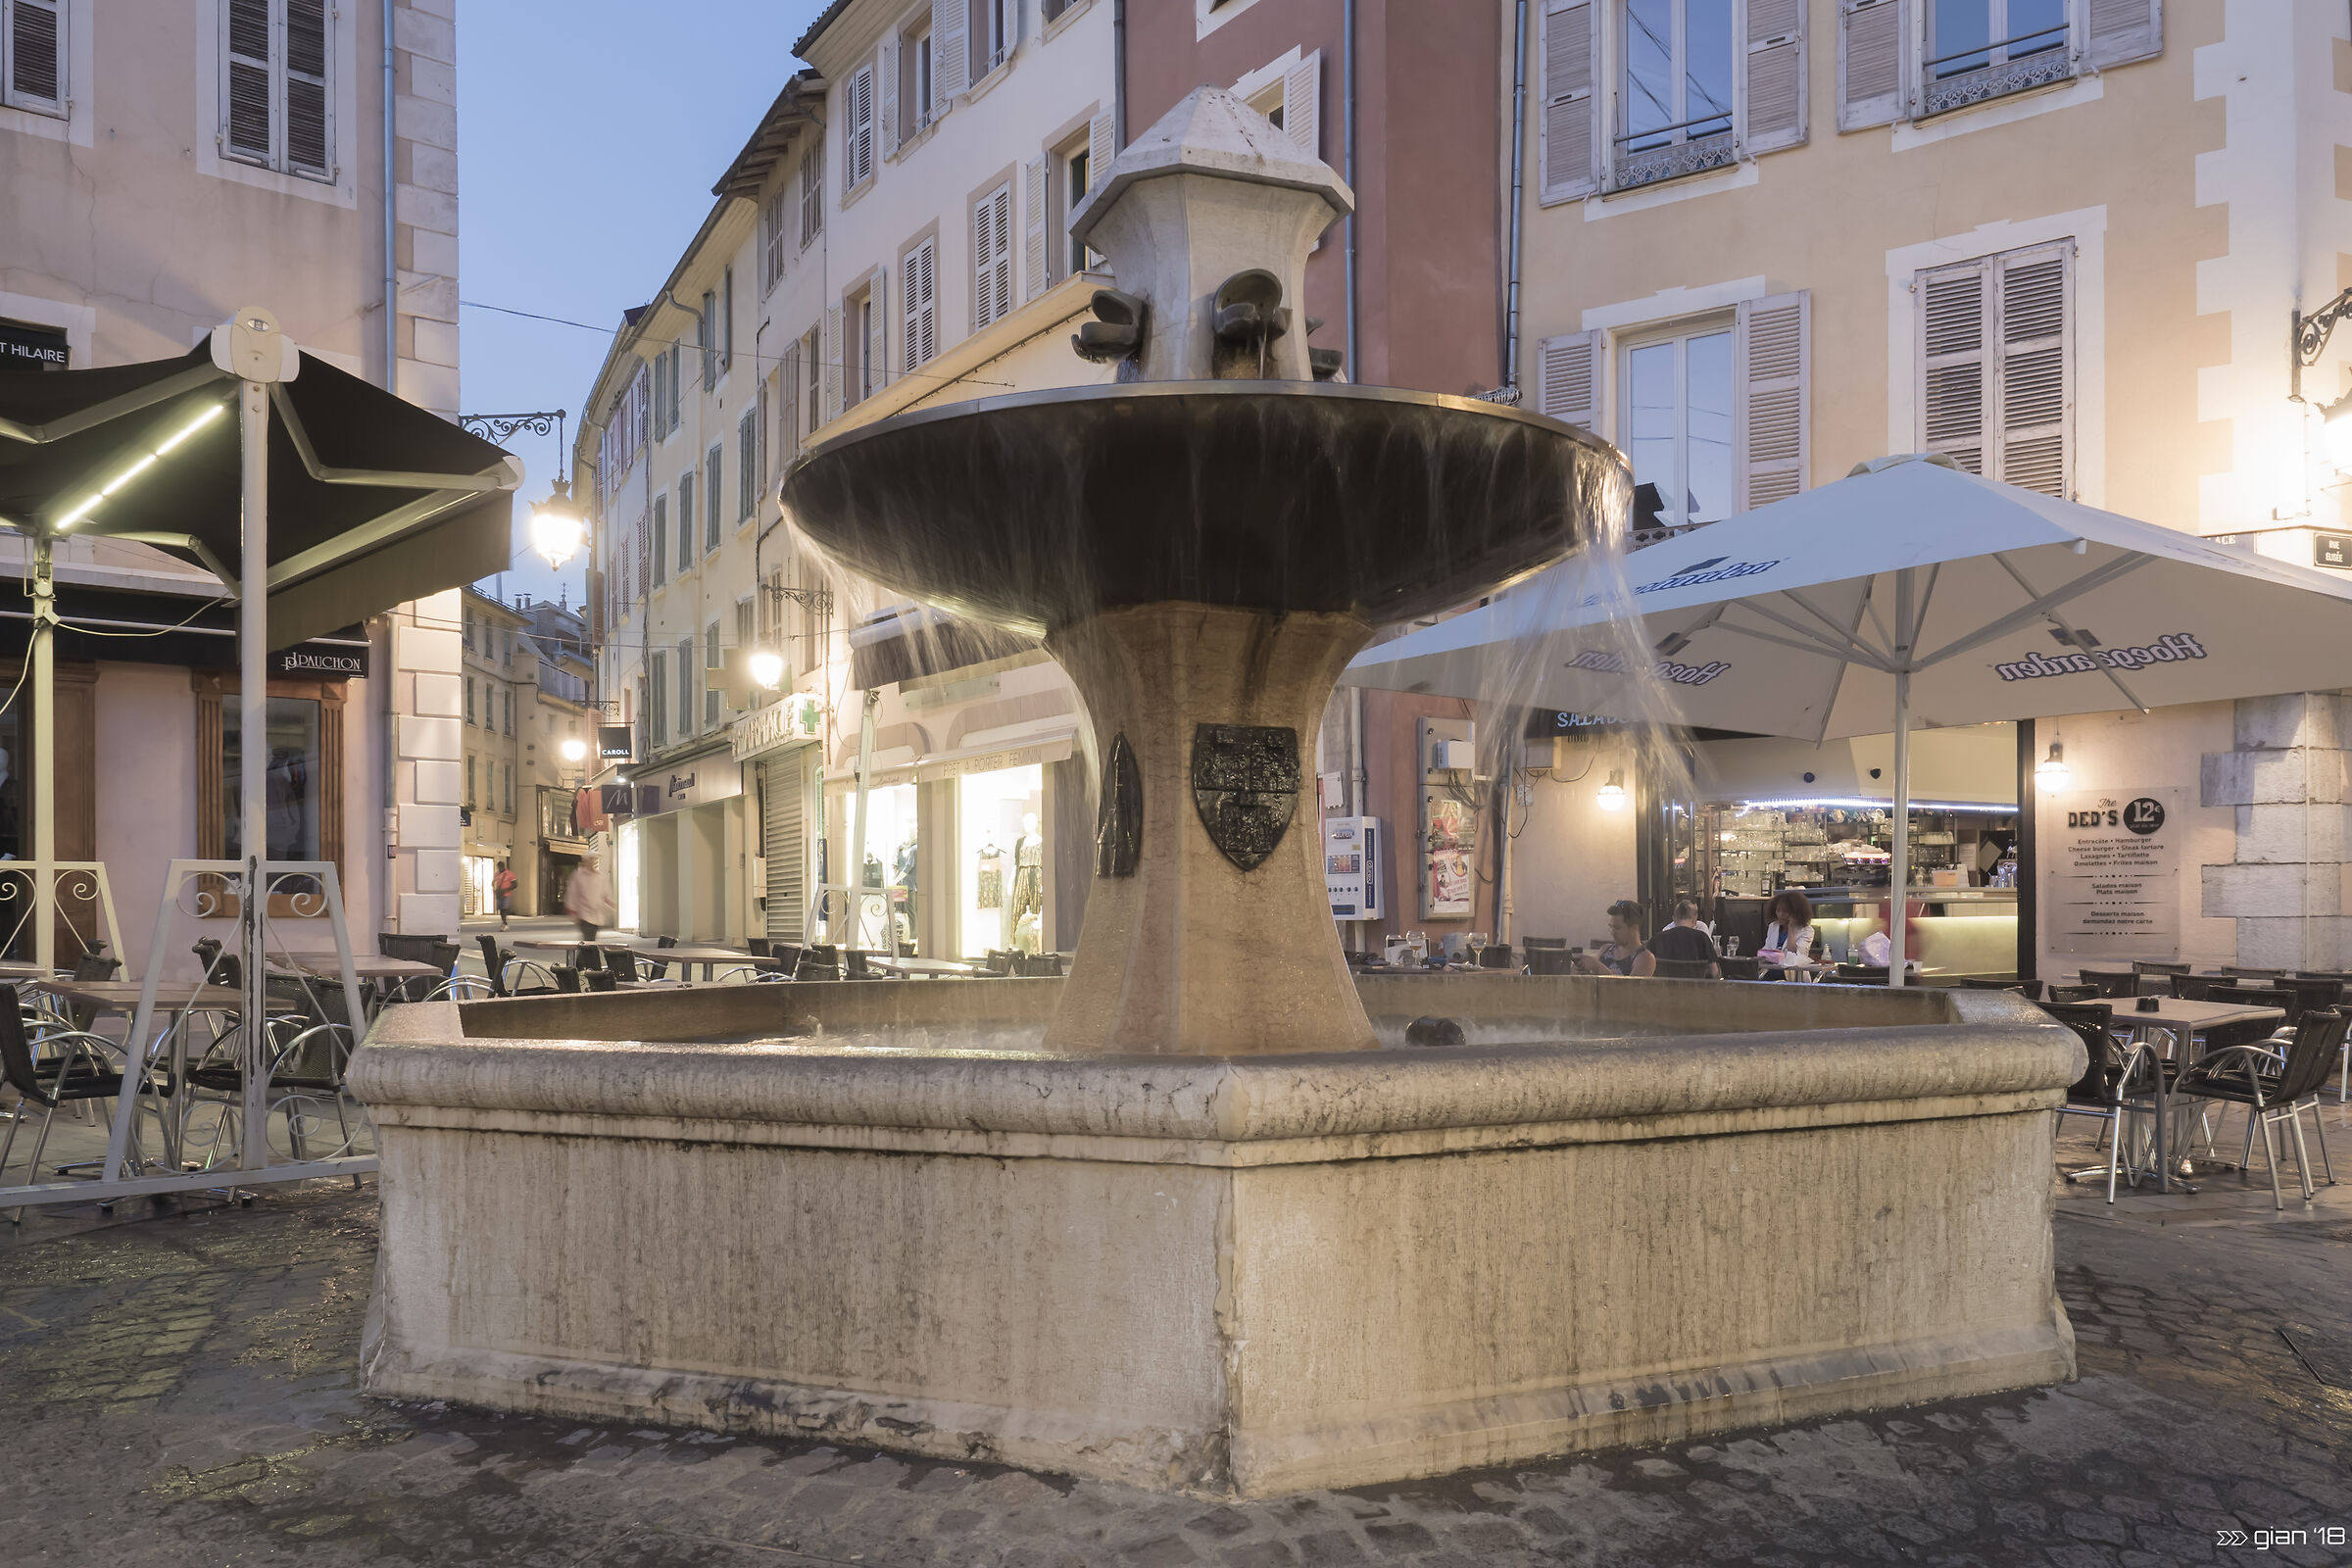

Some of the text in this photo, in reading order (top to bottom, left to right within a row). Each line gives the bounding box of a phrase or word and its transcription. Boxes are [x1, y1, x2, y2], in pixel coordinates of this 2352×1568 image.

[11, 344, 66, 363] HILAIRE
[2207, 535, 2236, 545] ACE
[2328, 540, 2340, 550] RUE
[298, 655, 361, 670] PAUCHON
[2097, 798, 2117, 808] The
[2068, 810, 2119, 827] DED'S
